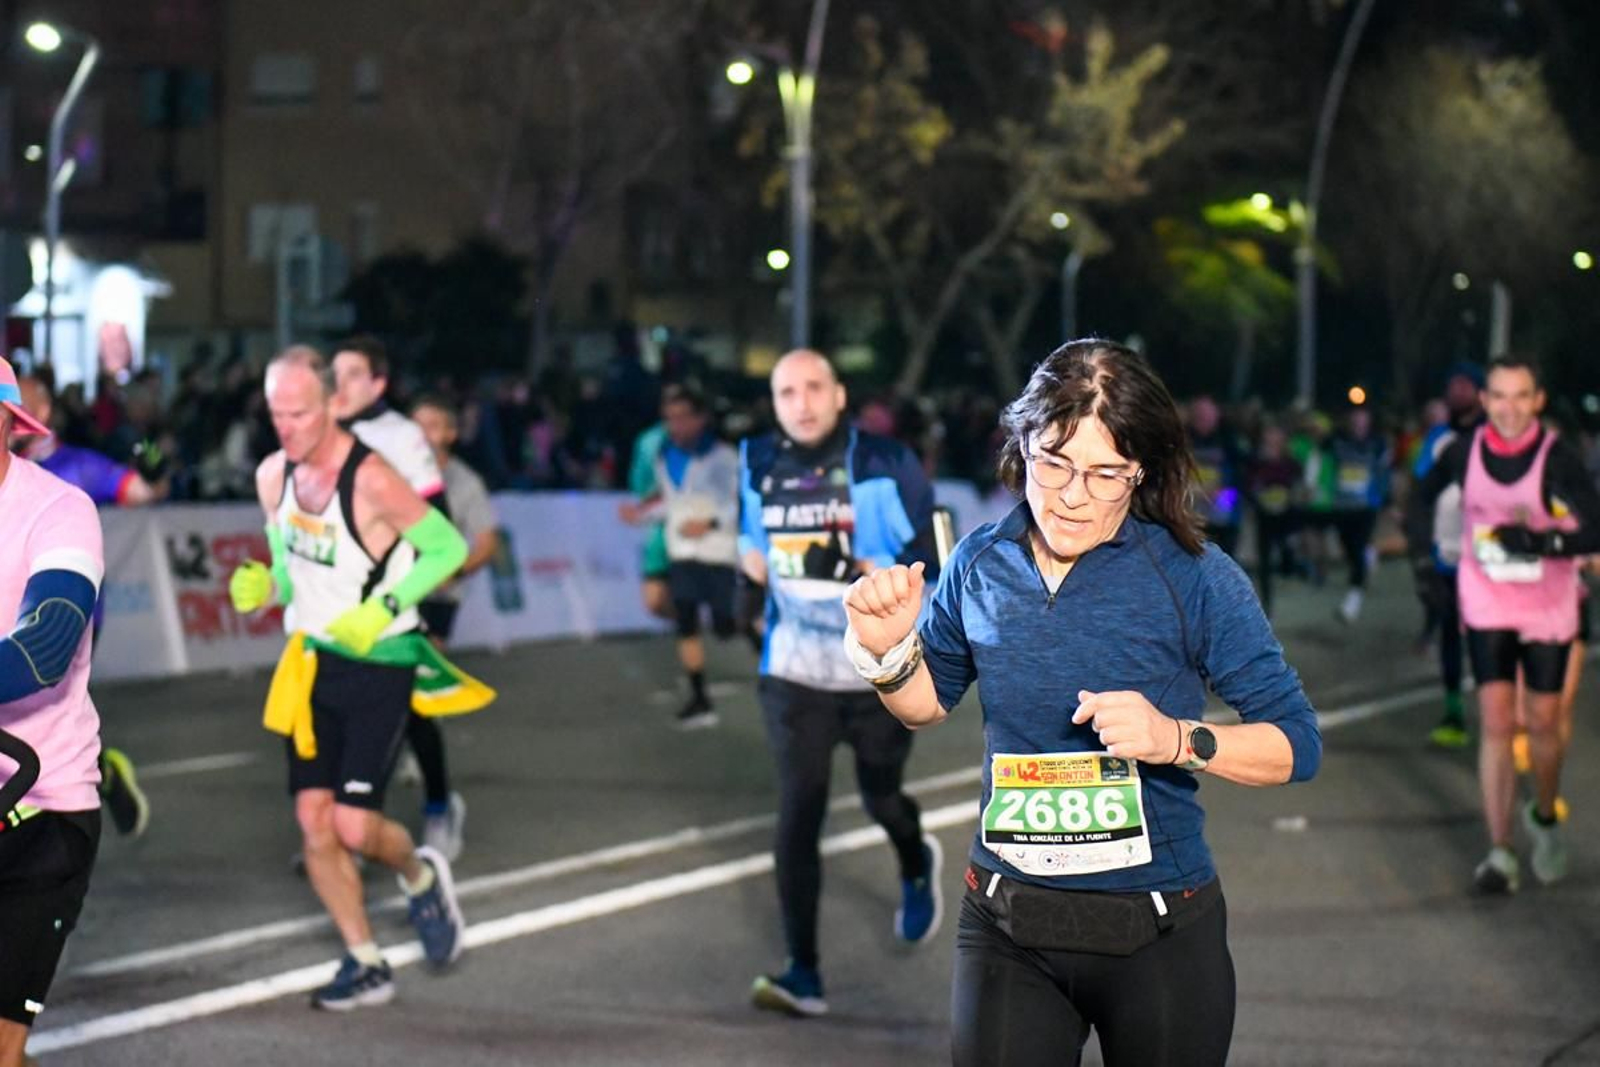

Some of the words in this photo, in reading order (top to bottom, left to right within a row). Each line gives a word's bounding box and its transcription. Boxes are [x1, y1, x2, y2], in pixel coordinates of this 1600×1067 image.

[1016, 761, 1041, 781] 42
[994, 788, 1129, 832] 2686
[1012, 834, 1029, 842] TINA
[1064, 834, 1074, 842] DE
[1075, 834, 1085, 842] LA
[1086, 832, 1112, 841] FUENTE
